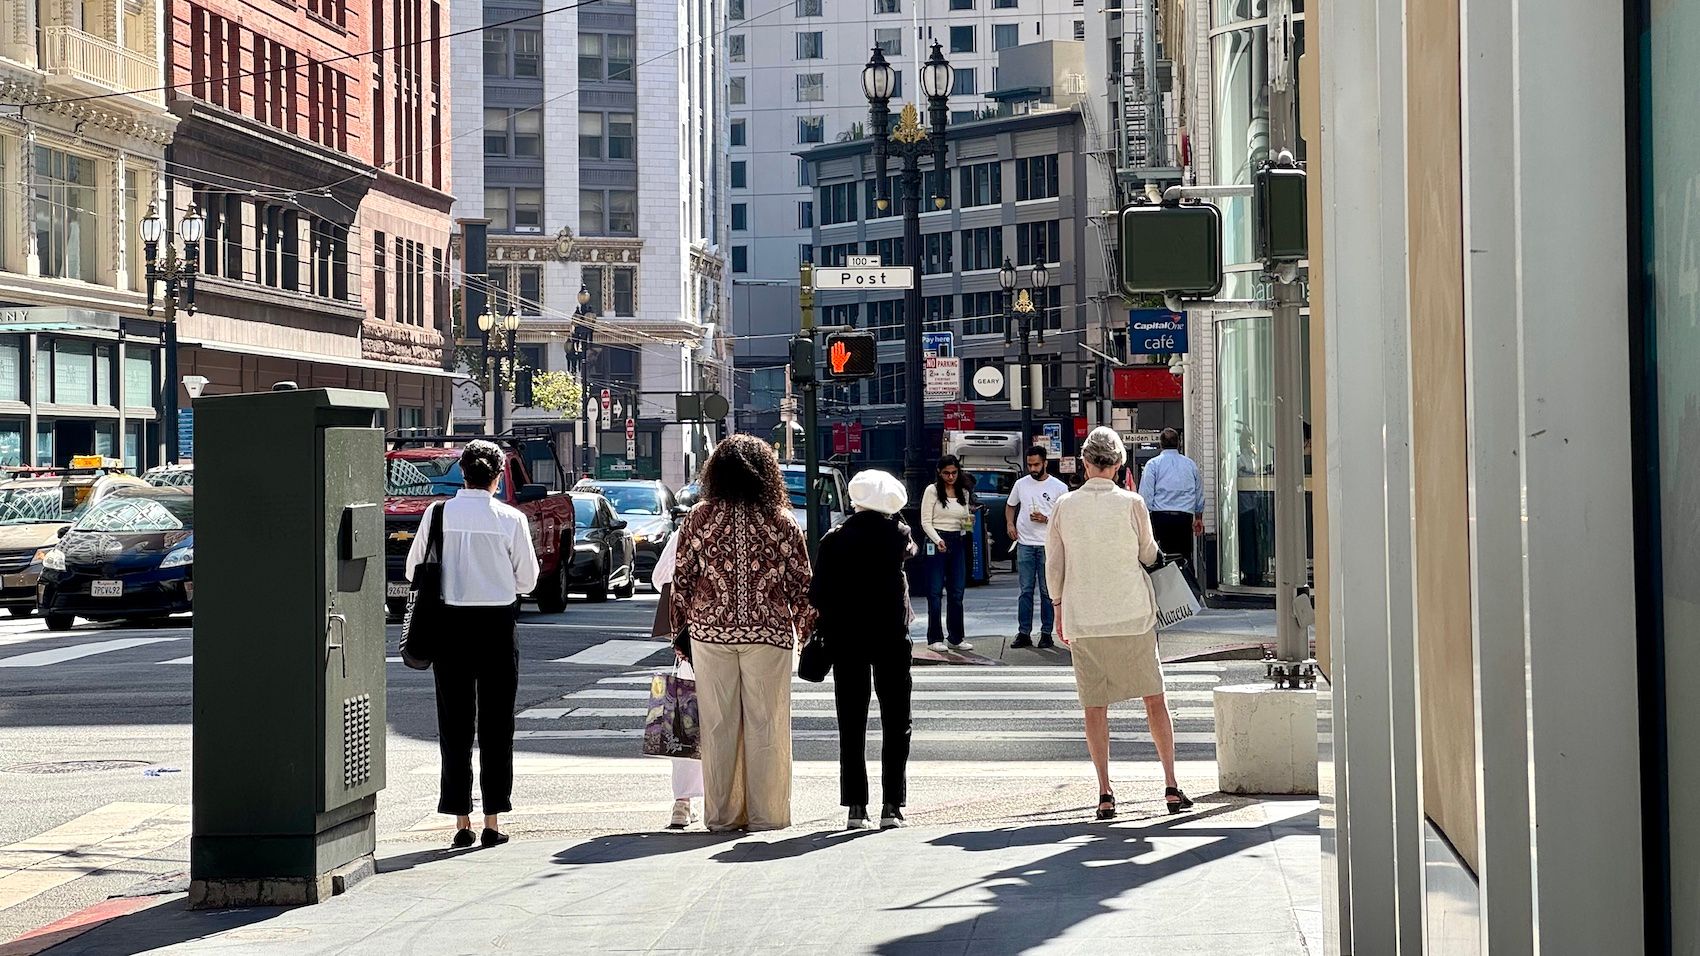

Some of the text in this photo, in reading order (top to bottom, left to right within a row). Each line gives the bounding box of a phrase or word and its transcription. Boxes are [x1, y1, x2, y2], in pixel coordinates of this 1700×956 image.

[852, 257, 867, 266] 100
[841, 272, 887, 285] Post
[0, 311, 28, 321] NY
[1144, 334, 1175, 350] café
[927, 358, 958, 368] NO PARKING
[1156, 603, 1193, 628] Marcus
